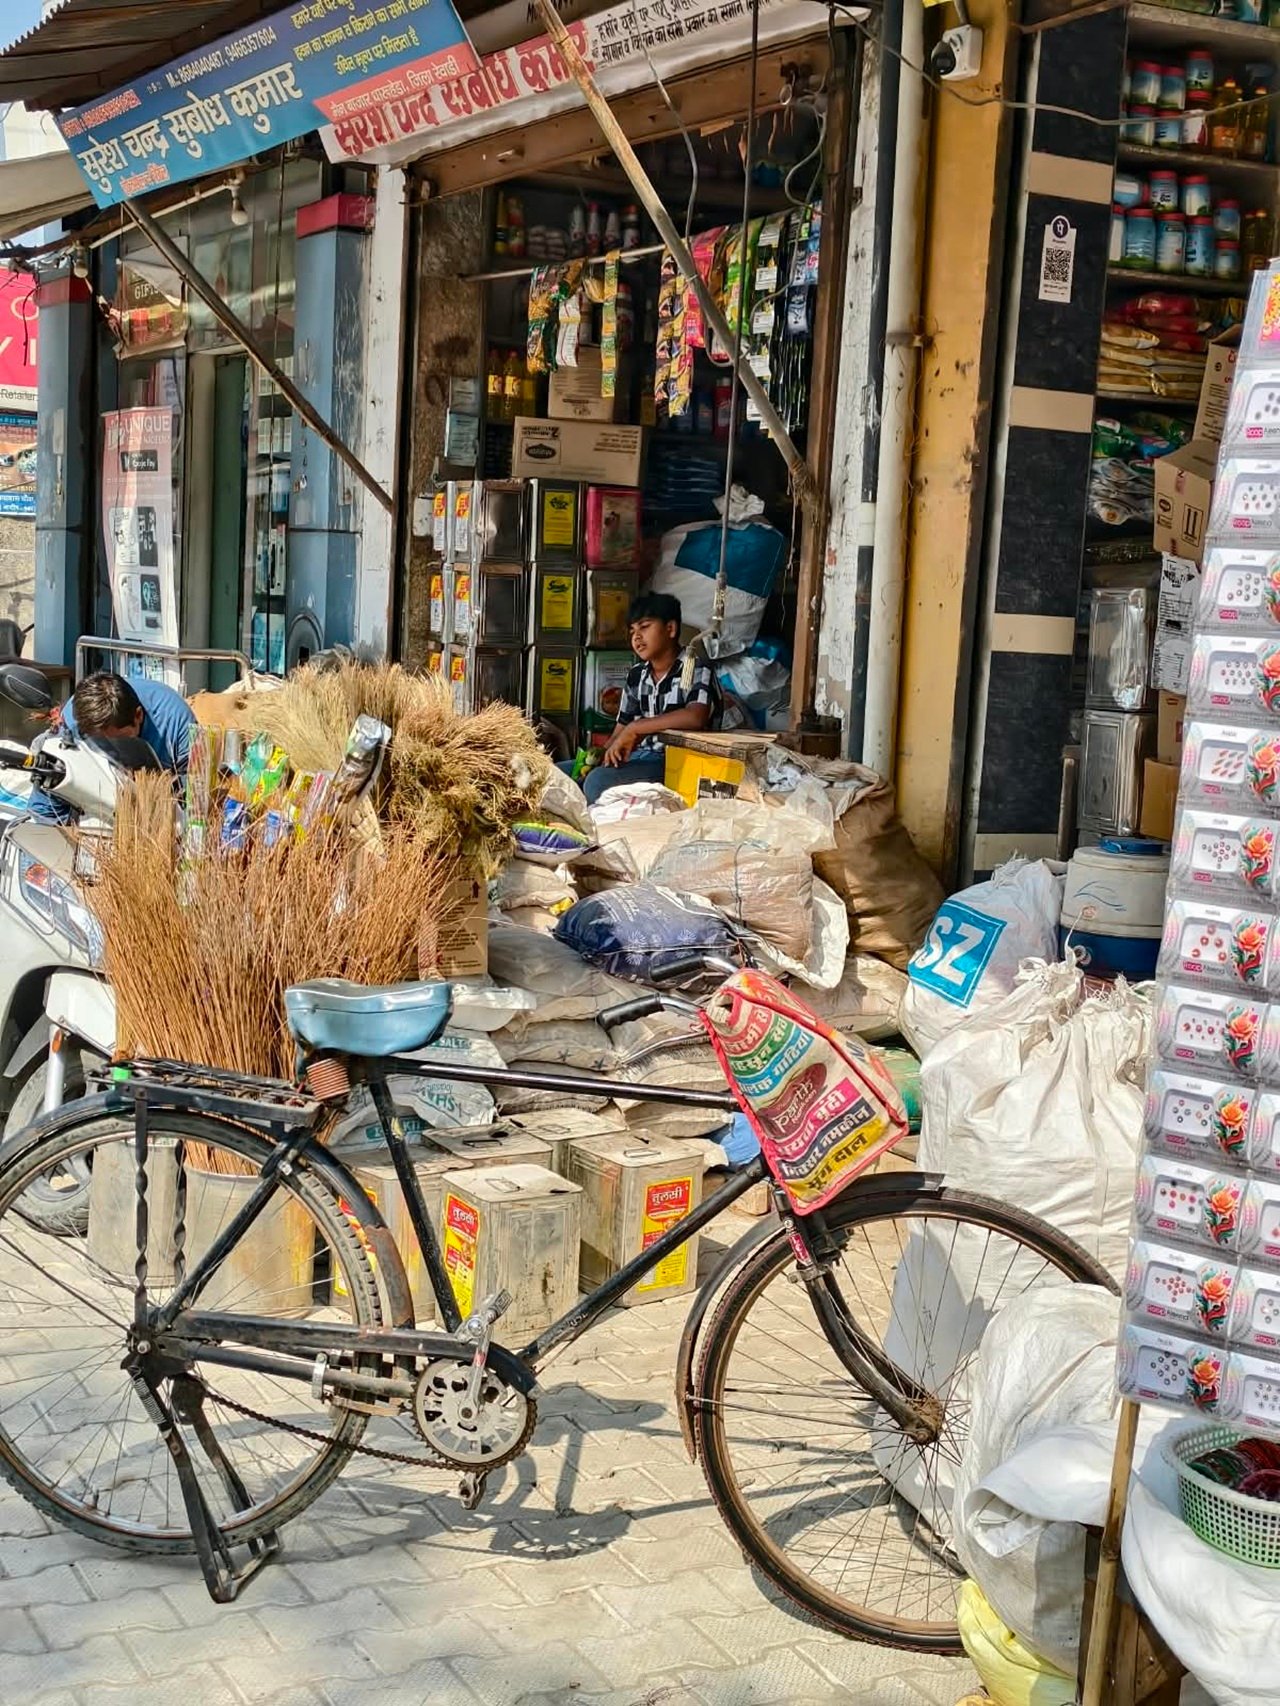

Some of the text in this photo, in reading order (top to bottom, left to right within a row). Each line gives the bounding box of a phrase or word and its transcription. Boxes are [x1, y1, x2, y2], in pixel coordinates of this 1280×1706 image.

[514, 20, 597, 94] कुमर
[76, 134, 128, 193] सुरेश
[162, 90, 231, 159] सुबोध
[224, 62, 303, 134] कुमार
[124, 415, 170, 434] UNIQUE
[819, 1105, 870, 1148] नमकीन
[832, 1133, 868, 1163] दाल
[652, 1186, 683, 1206] तुलसी
